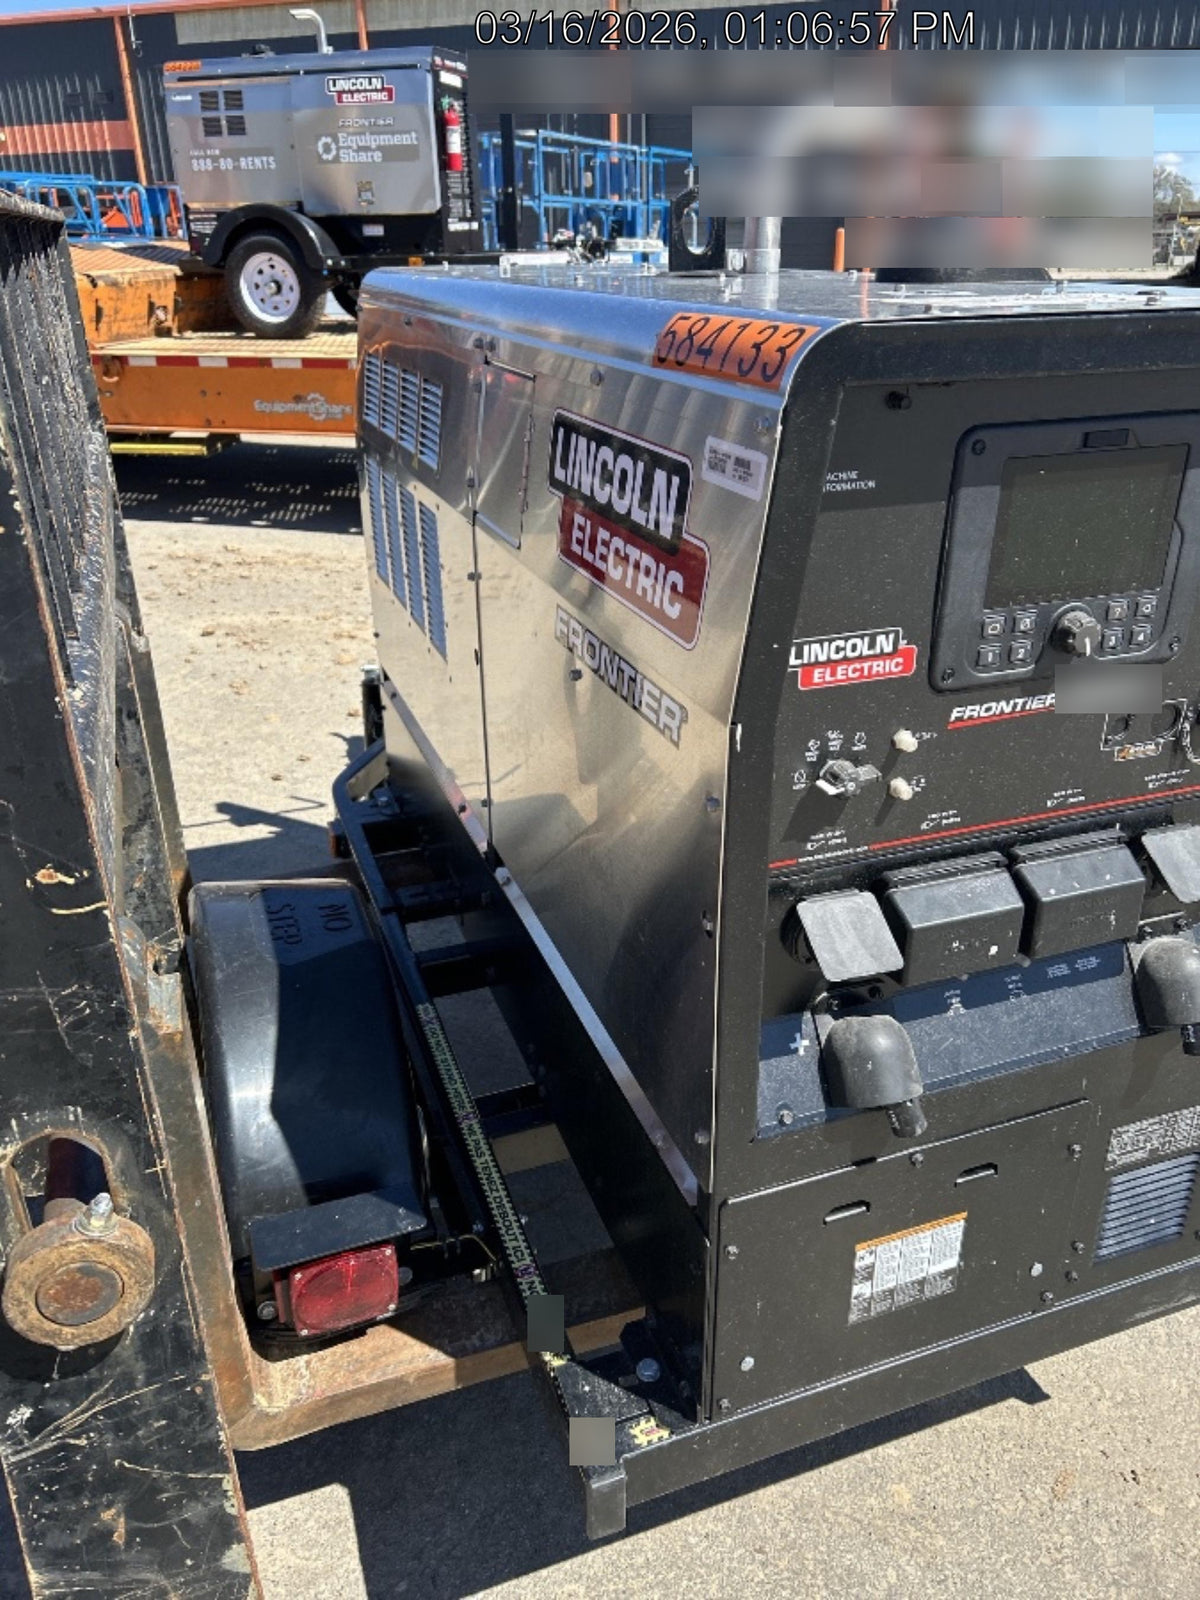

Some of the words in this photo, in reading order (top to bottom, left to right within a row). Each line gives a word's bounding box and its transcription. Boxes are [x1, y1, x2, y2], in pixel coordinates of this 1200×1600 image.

[328, 78, 382, 91] LINCOLN
[341, 91, 389, 103] ELECTRIC
[338, 131, 419, 150] Equipment
[339, 148, 383, 162] Share
[656, 315, 806, 383] 584133
[554, 427, 680, 540] LINCOLN
[826, 471, 860, 481] ACHINE
[571, 513, 684, 620] ELECTRIC
[788, 632, 895, 666] LINCOLN
[554, 604, 682, 749] FRONTIER
[812, 657, 904, 683] ELECTRIC
[949, 692, 1055, 722] FRONTIER
[265, 903, 303, 945] STEP
[318, 904, 353, 932] NO
[470, 1138, 486, 1159] PAS
[512, 1244, 526, 1262] ICI
